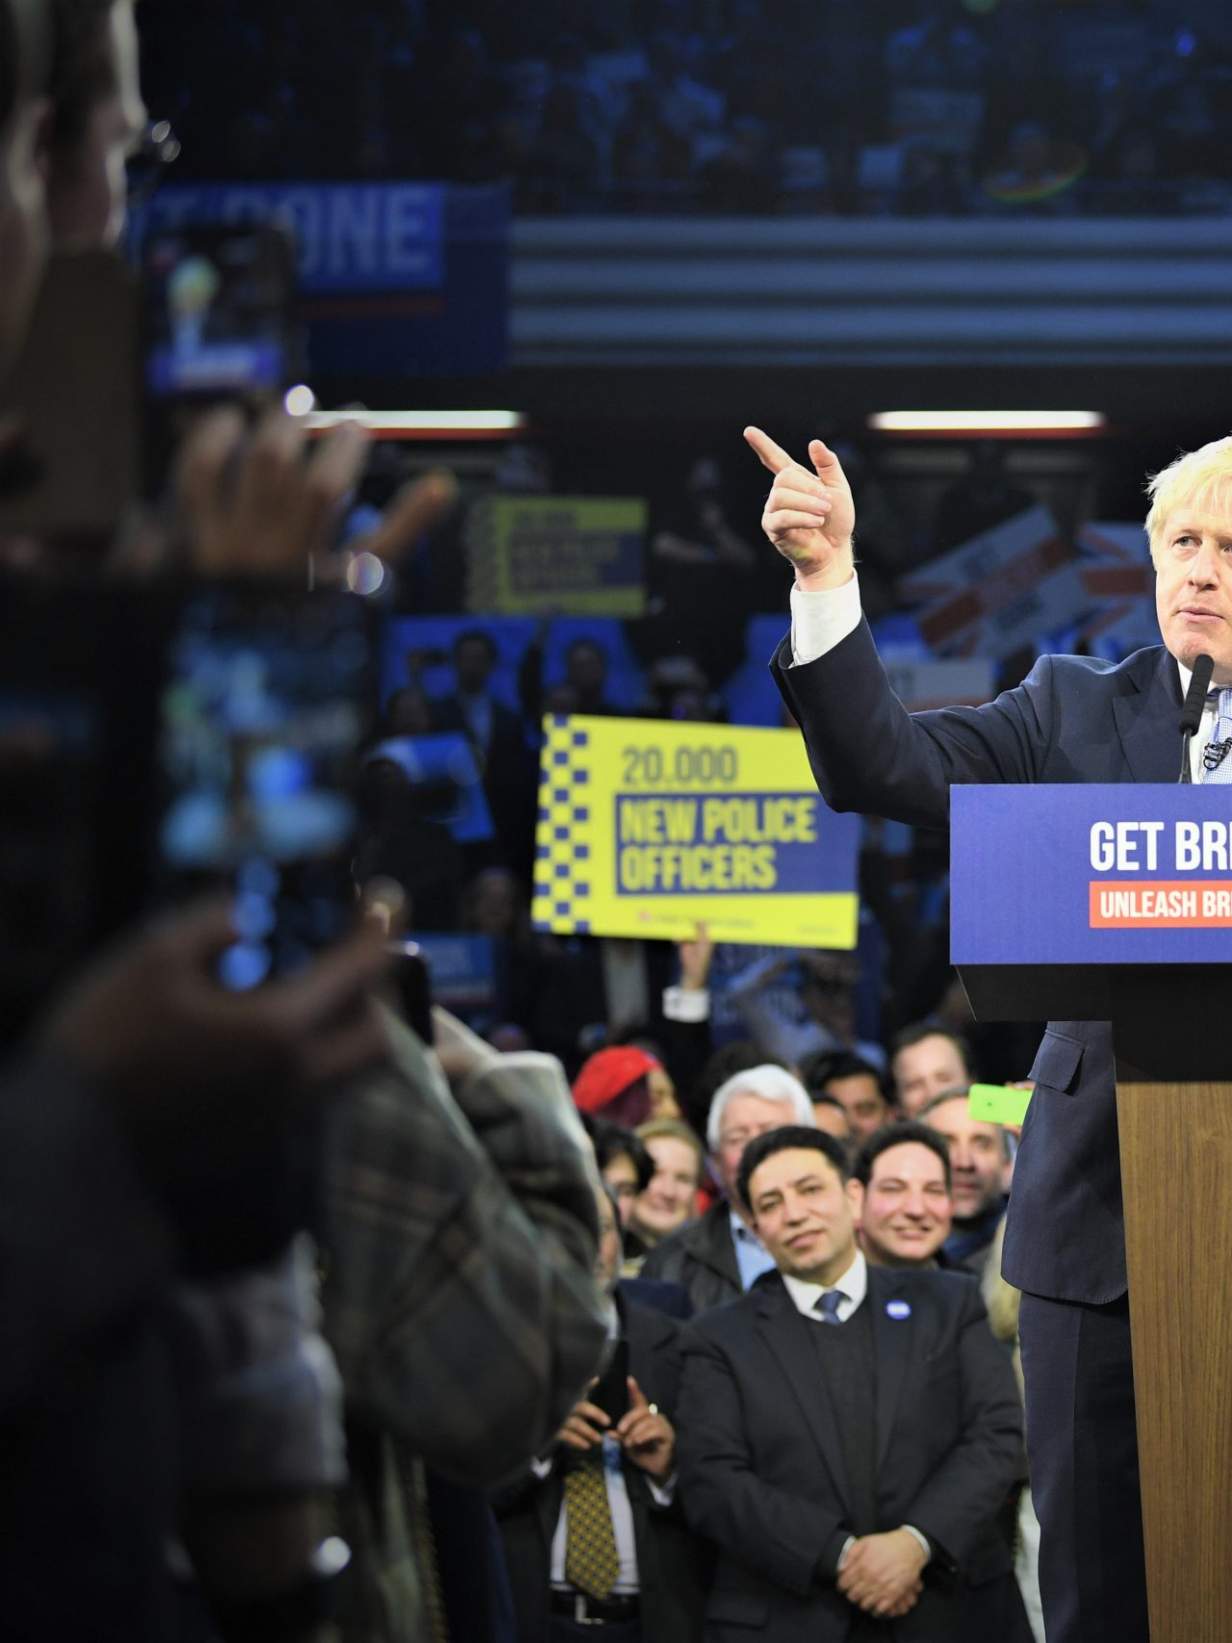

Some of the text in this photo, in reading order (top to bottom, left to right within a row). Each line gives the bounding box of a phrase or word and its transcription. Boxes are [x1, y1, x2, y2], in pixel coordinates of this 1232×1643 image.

[222, 186, 427, 275] ONE
[620, 797, 817, 843] NEW POLICE
[620, 846, 778, 890] OFFICERS
[1089, 821, 1164, 871] GET
[1100, 890, 1197, 919] UNLEASH
